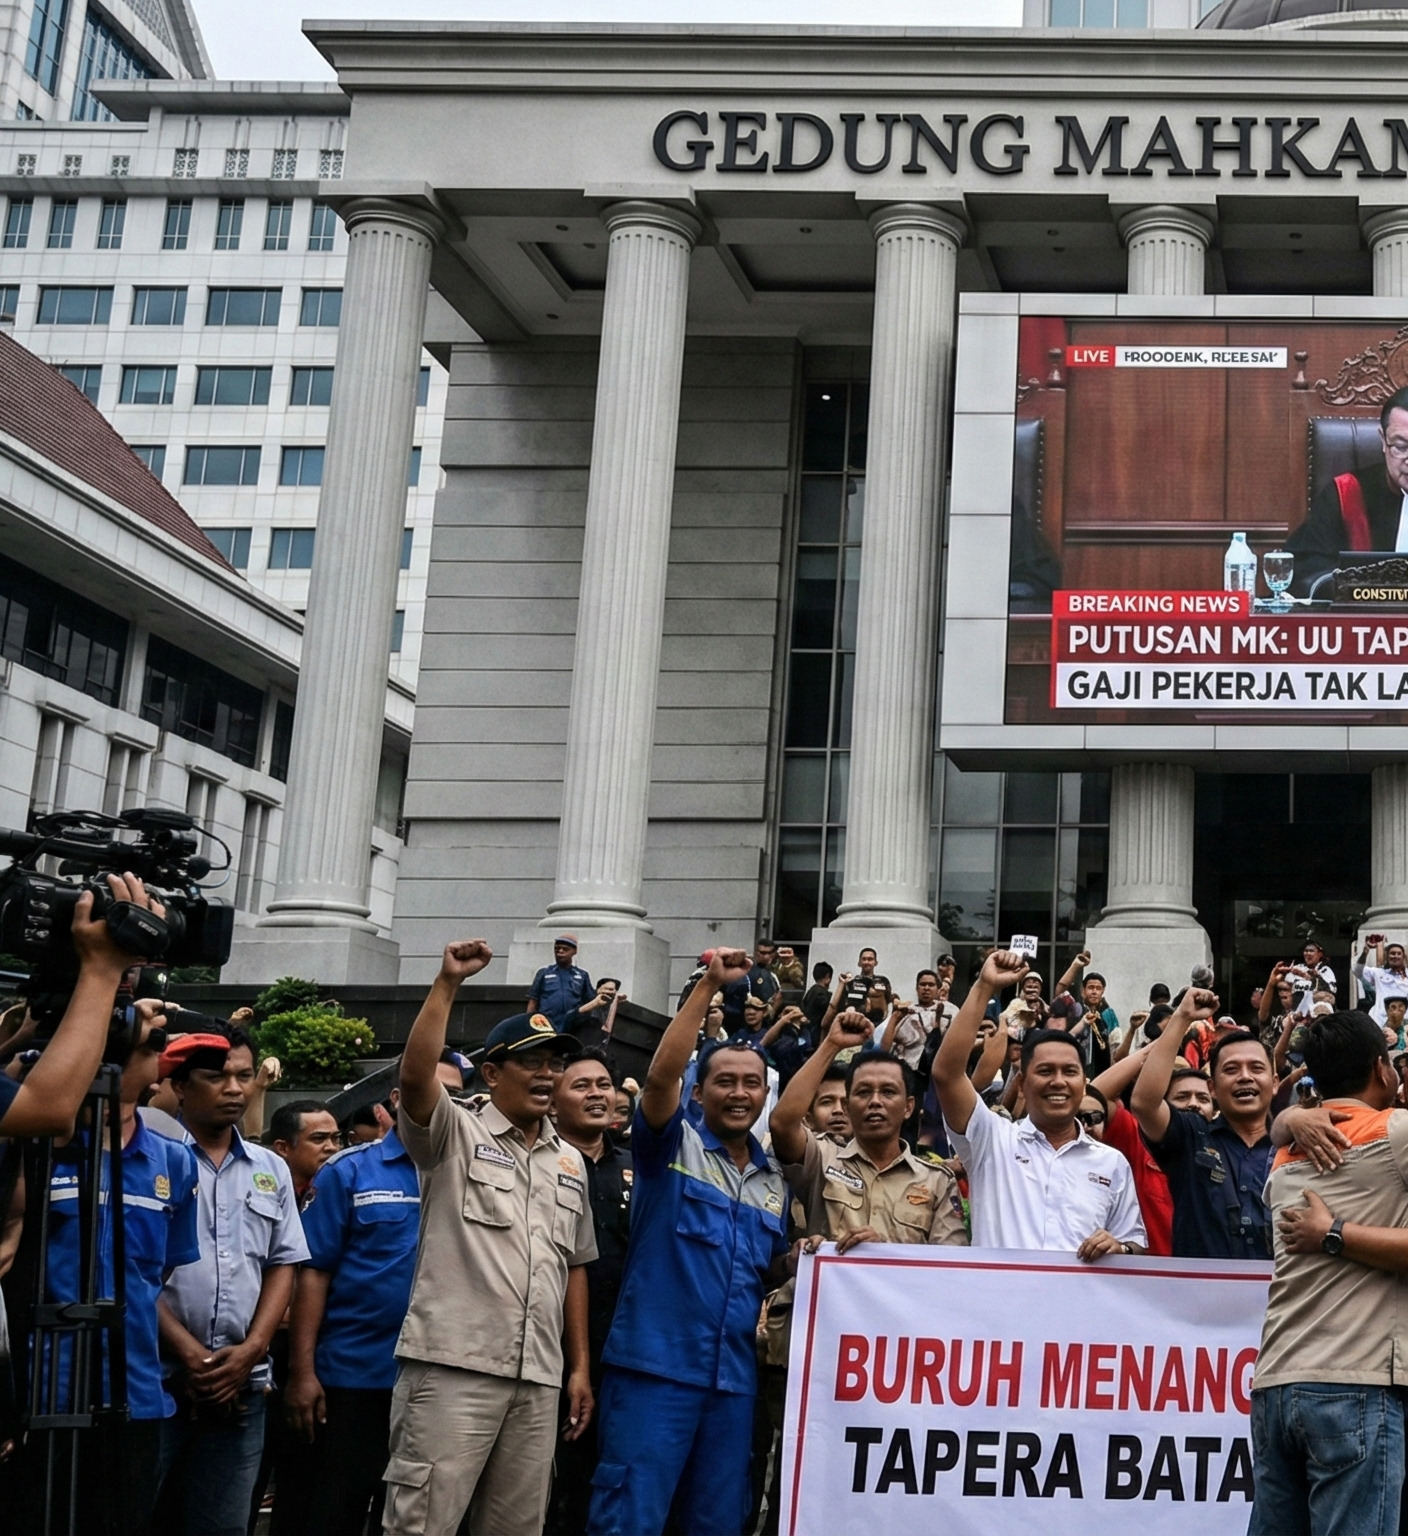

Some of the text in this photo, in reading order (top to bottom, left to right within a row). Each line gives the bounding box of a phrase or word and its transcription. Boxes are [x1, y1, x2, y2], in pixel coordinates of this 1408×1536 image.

[652, 110, 1031, 175] GEDUNG
[1073, 350, 1109, 363] LIVE
[1068, 595, 1241, 613] BREAKING NEWS
[1069, 625, 1221, 655] PUTUSAN
[1232, 626, 1289, 655] MK:
[1298, 626, 1343, 655] UU
[1067, 670, 1141, 700] GAJI
[1152, 671, 1297, 701] PEKERJA
[1304, 671, 1368, 701] TAK
[835, 1335, 1259, 1414] BURUH MENANG
[844, 1426, 1084, 1499] TAPERA
